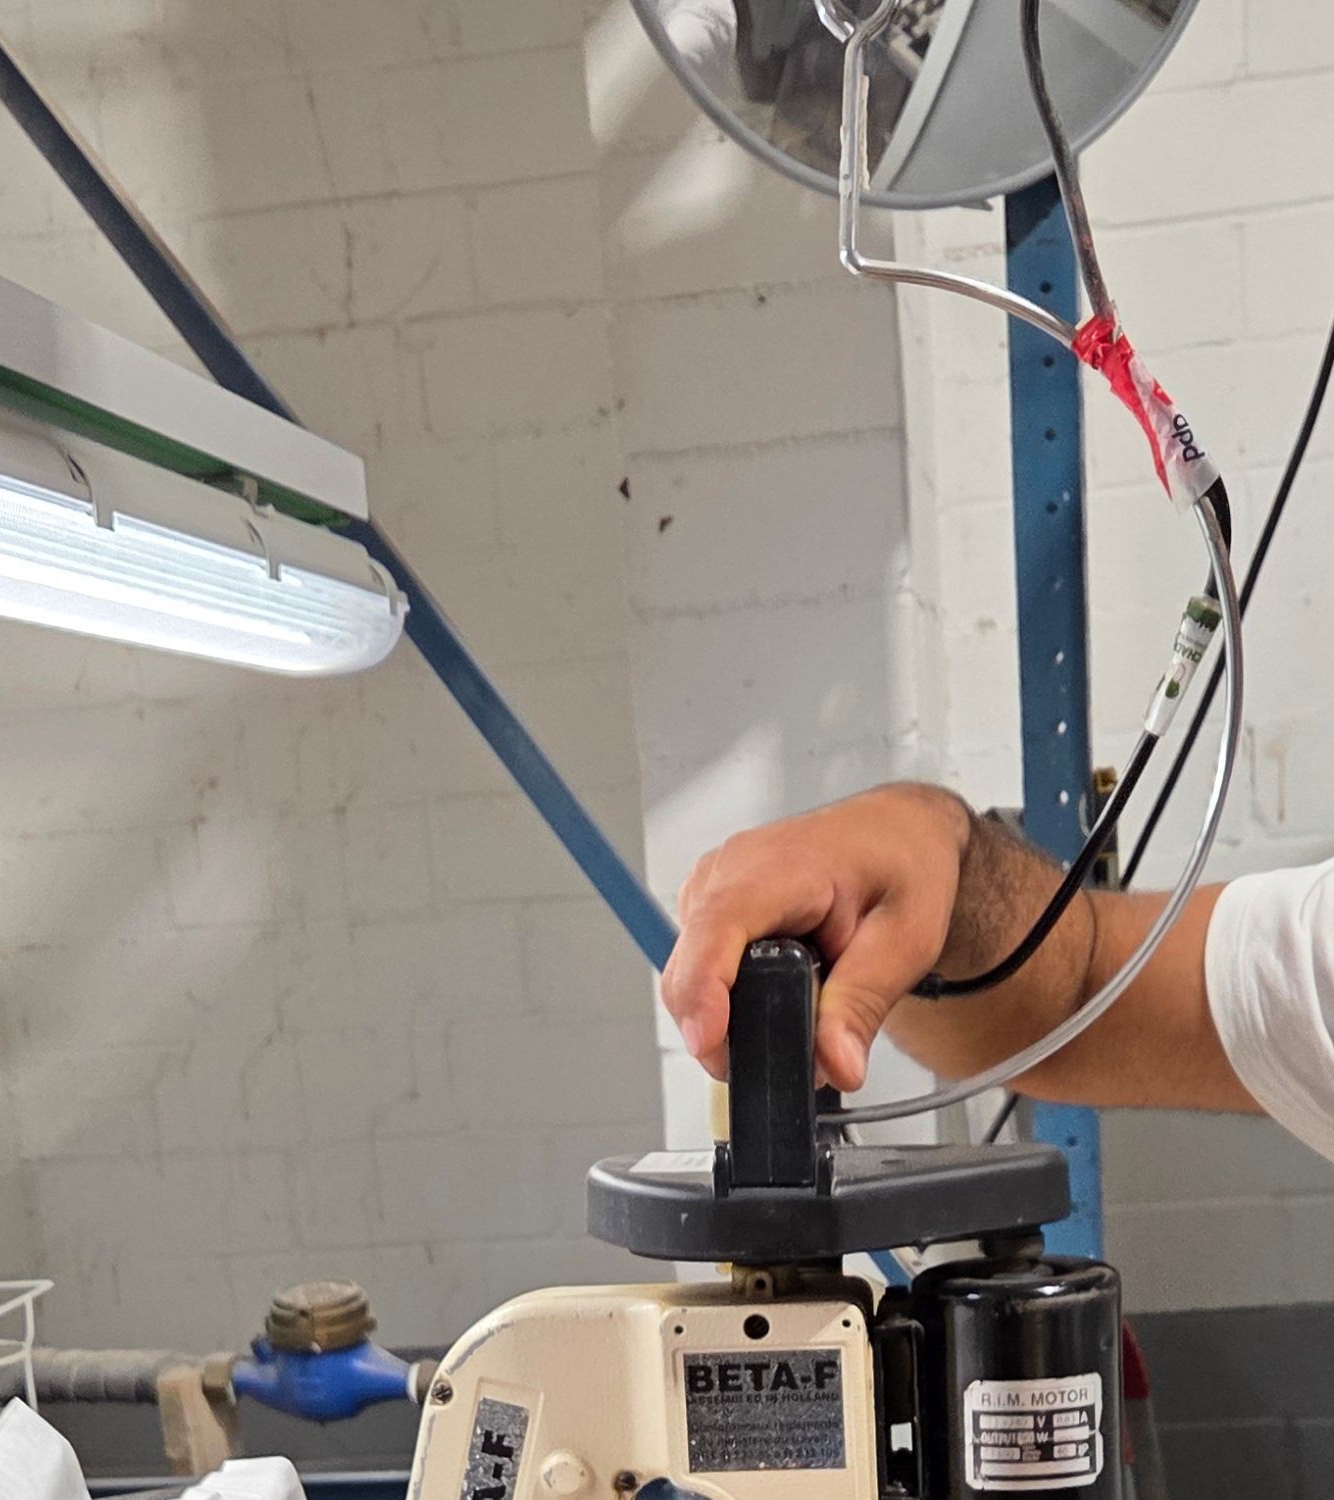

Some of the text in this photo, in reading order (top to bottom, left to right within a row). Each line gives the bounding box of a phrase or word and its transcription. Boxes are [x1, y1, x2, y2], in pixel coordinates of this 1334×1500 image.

[687, 1361, 837, 1393] BETA-F
[980, 1388, 1088, 1406] R.I.M. MOTOR
[1037, 1415, 1046, 1428] V
[1080, 1410, 1088, 1423] A
